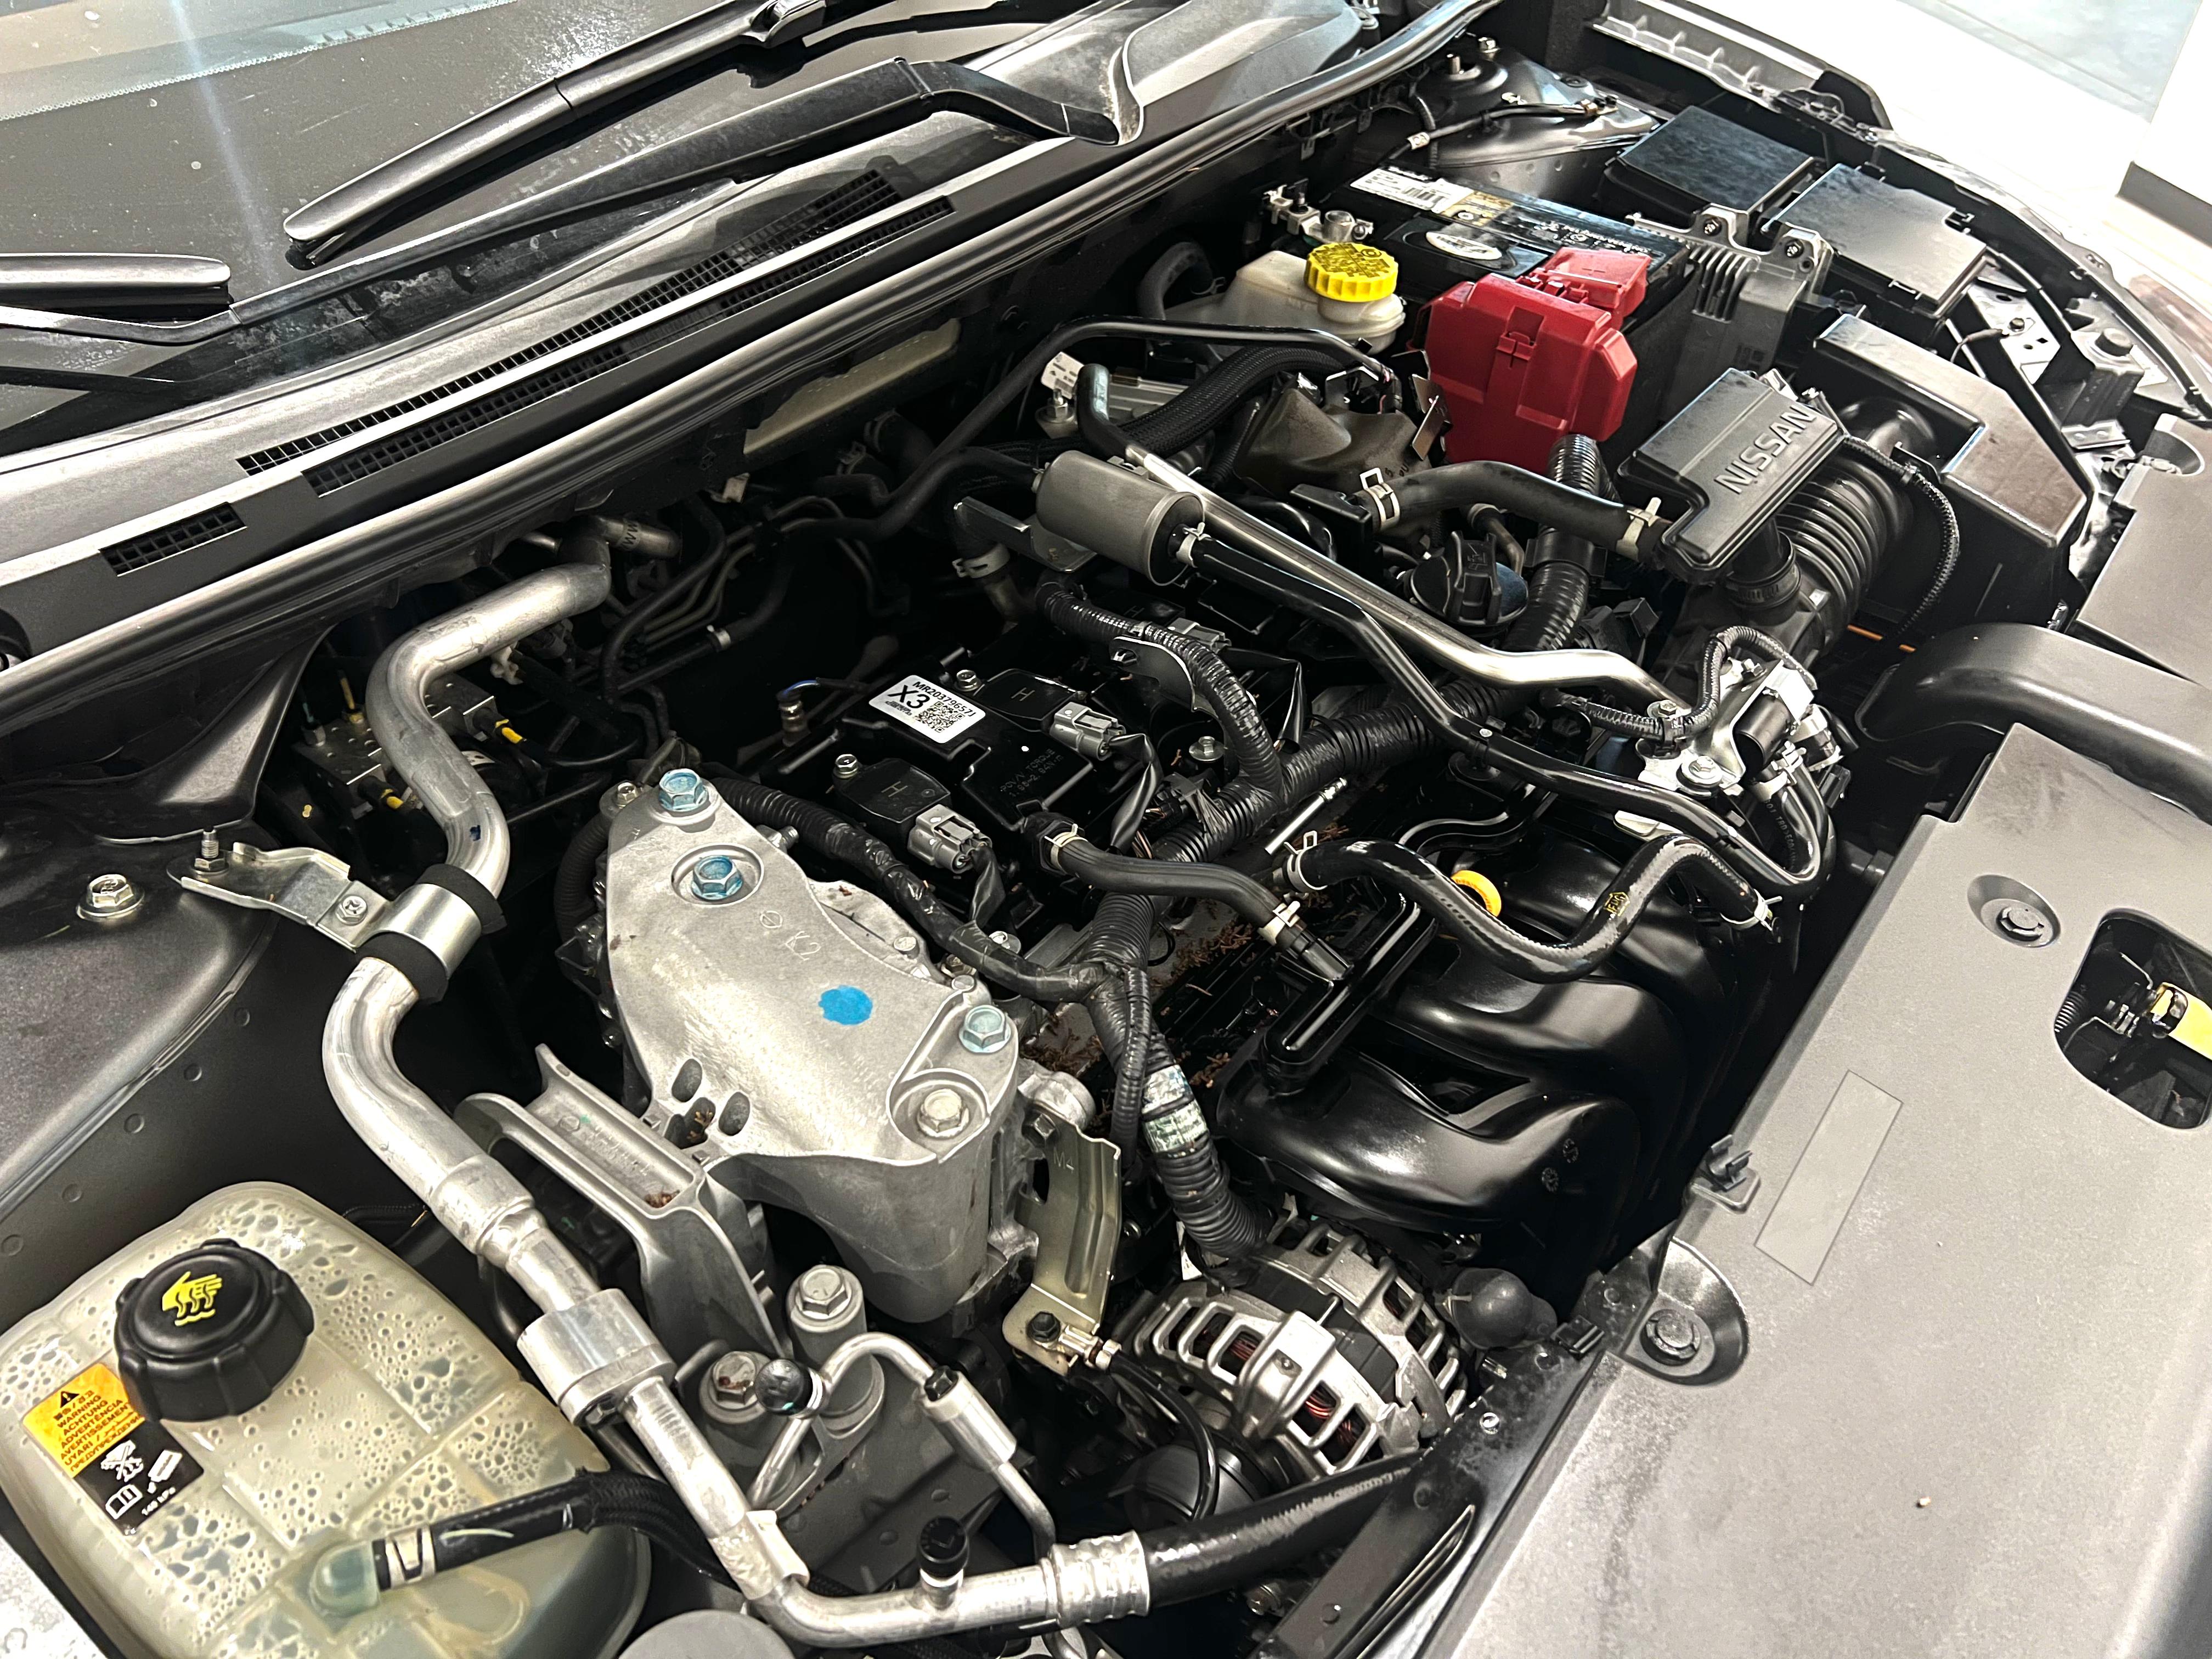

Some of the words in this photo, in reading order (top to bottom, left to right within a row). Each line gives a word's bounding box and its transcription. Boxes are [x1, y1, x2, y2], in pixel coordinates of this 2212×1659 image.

[1714, 405, 1816, 494] NISSAN
[888, 685, 930, 708] X3
[912, 681, 977, 717] MR20379657J
[1011, 687, 1035, 701] H
[881, 781, 908, 797] H
[1053, 1146, 1075, 1174] M4
[57, 1395, 101, 1427] WARNING
[63, 1400, 108, 1436] ACHTUNG
[65, 1441, 94, 1465] UYARI
